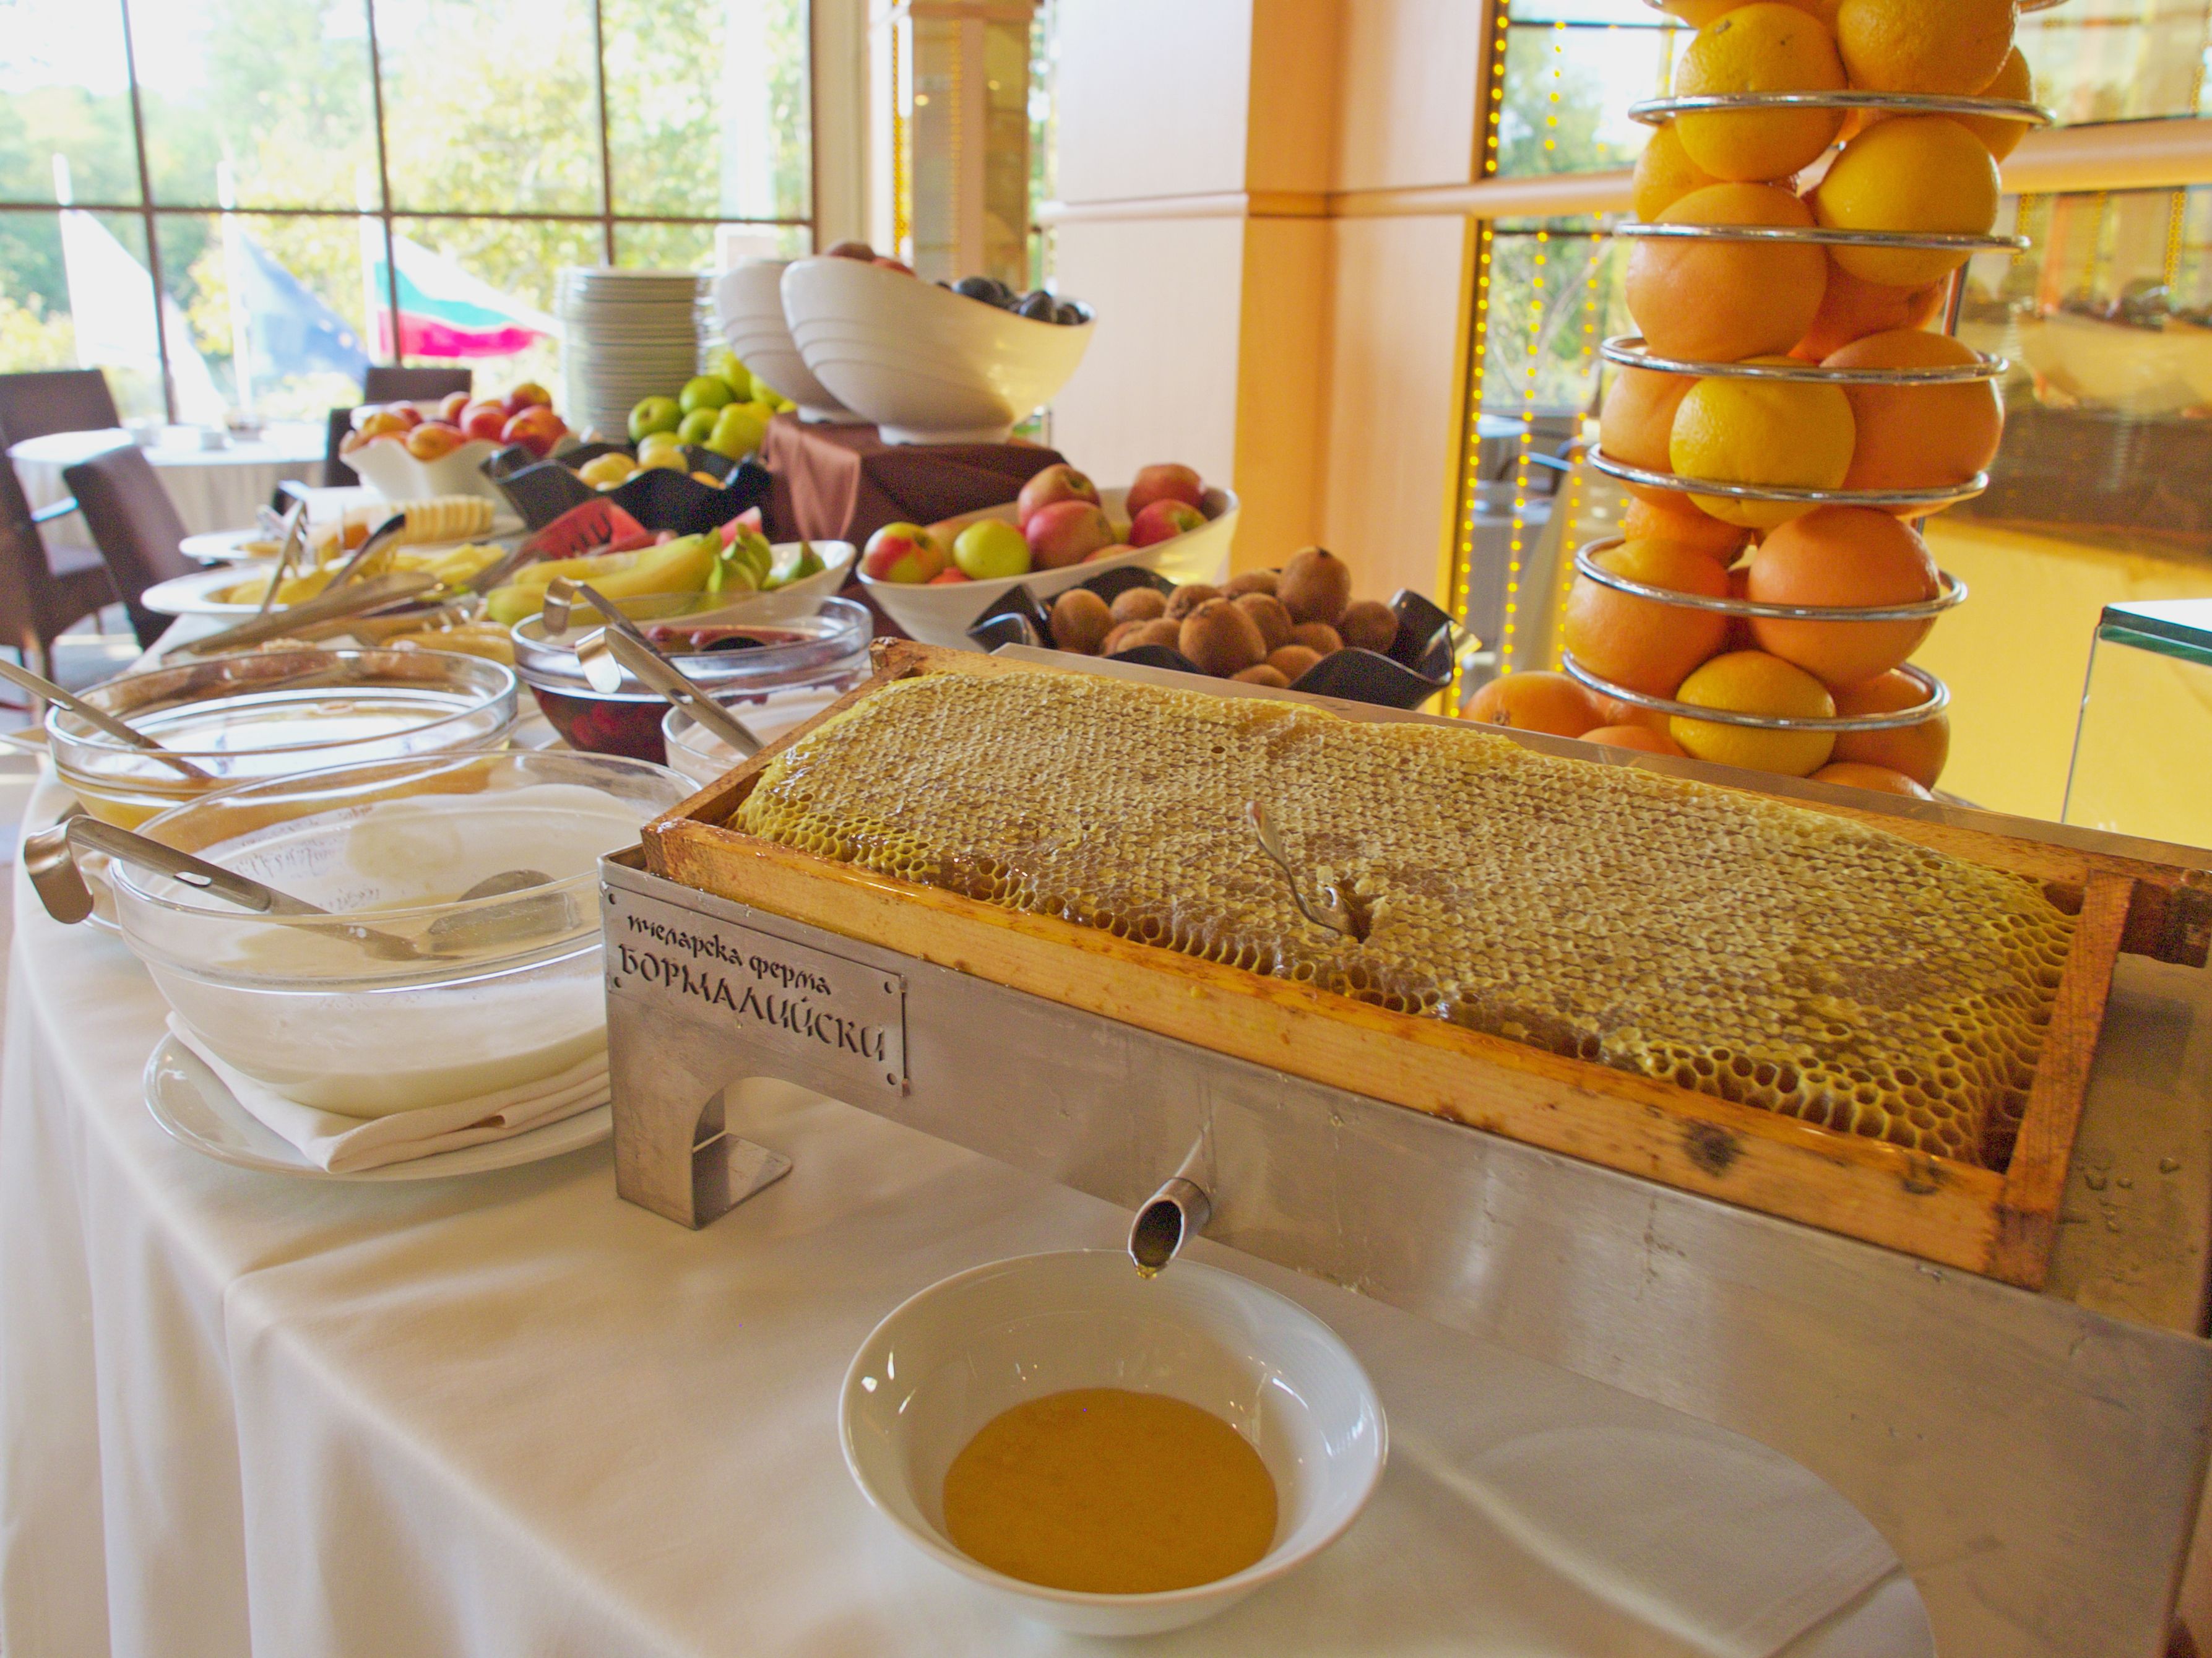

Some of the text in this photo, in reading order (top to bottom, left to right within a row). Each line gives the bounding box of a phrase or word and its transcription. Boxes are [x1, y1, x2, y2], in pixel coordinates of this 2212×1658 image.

[618, 944, 885, 1061] БОРМАЛИЙСКИ
[627, 915, 831, 995] пчеларска ферма
